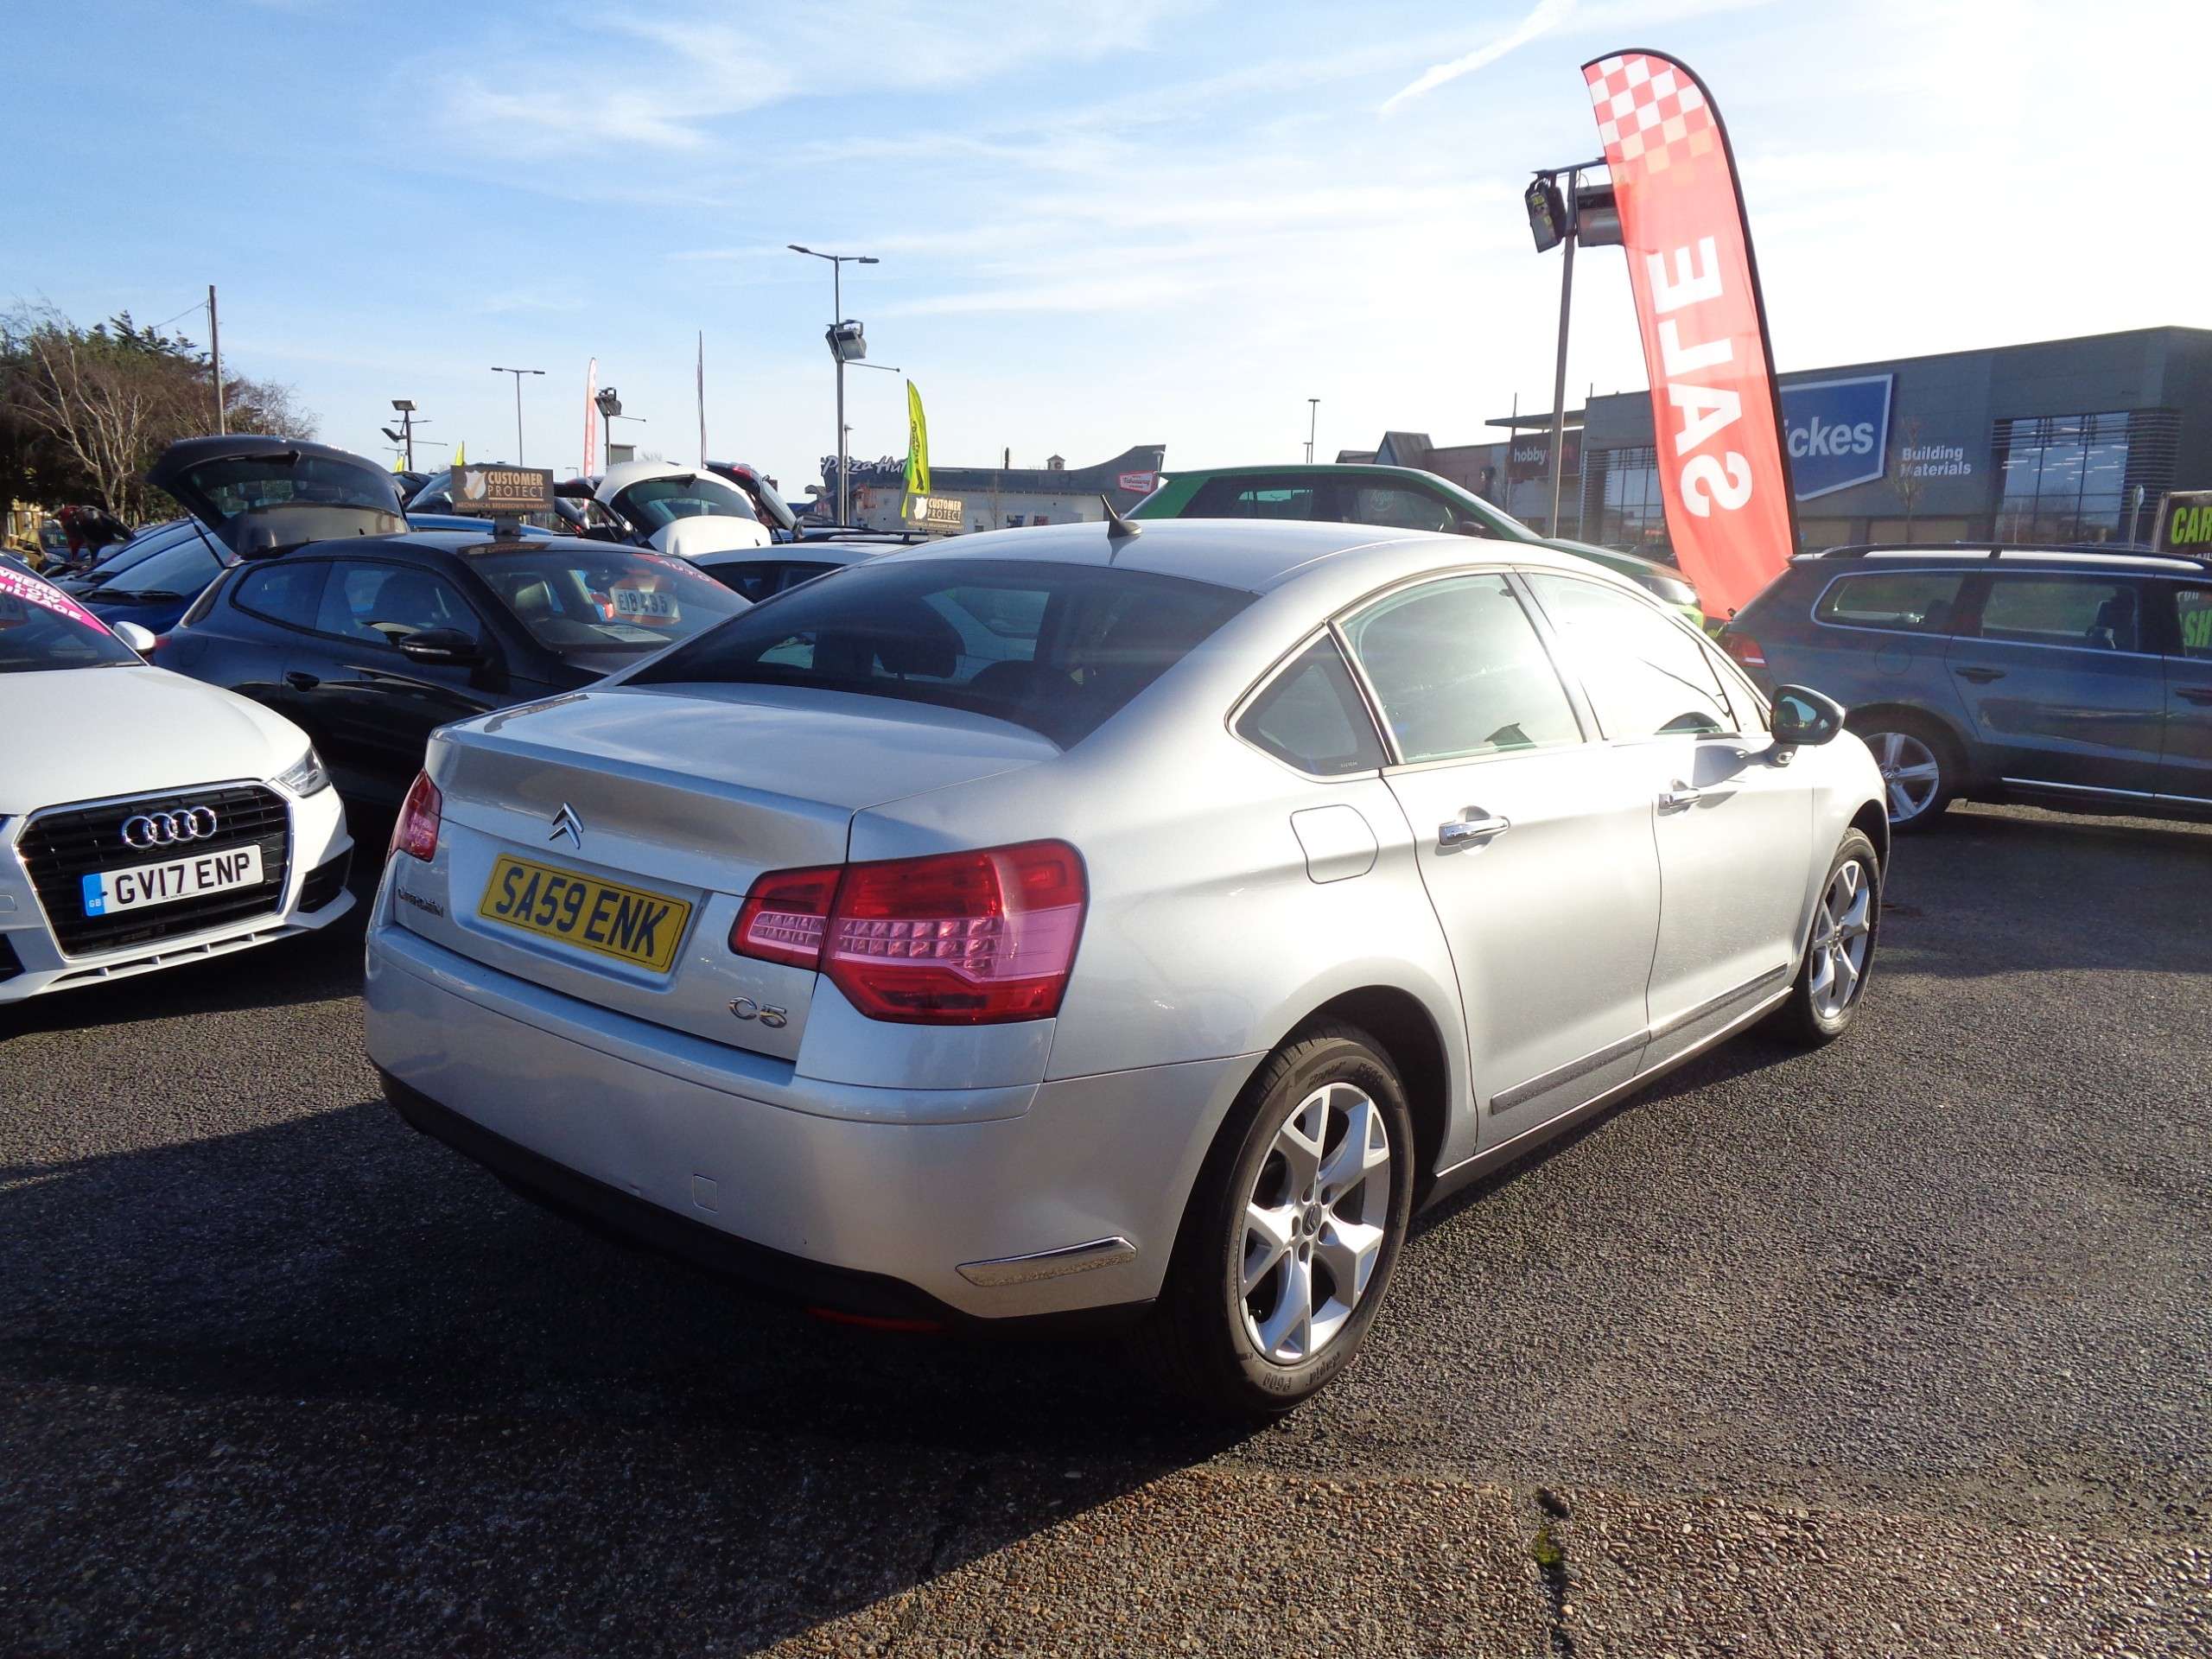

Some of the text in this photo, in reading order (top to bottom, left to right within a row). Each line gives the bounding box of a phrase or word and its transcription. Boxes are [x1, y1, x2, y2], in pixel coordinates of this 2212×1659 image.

[1902, 446, 1964, 461] Building
[487, 471, 543, 486] CUSTOMER
[487, 486, 544, 498] PROTECT
[928, 498, 962, 512] CUSTOMER
[927, 508, 962, 520] PROTECT
[115, 852, 250, 905] GV17 ENP
[89, 899, 102, 908] GB
[495, 866, 588, 933] SA59
[583, 888, 671, 958] ENK
[728, 995, 788, 1029] C5
